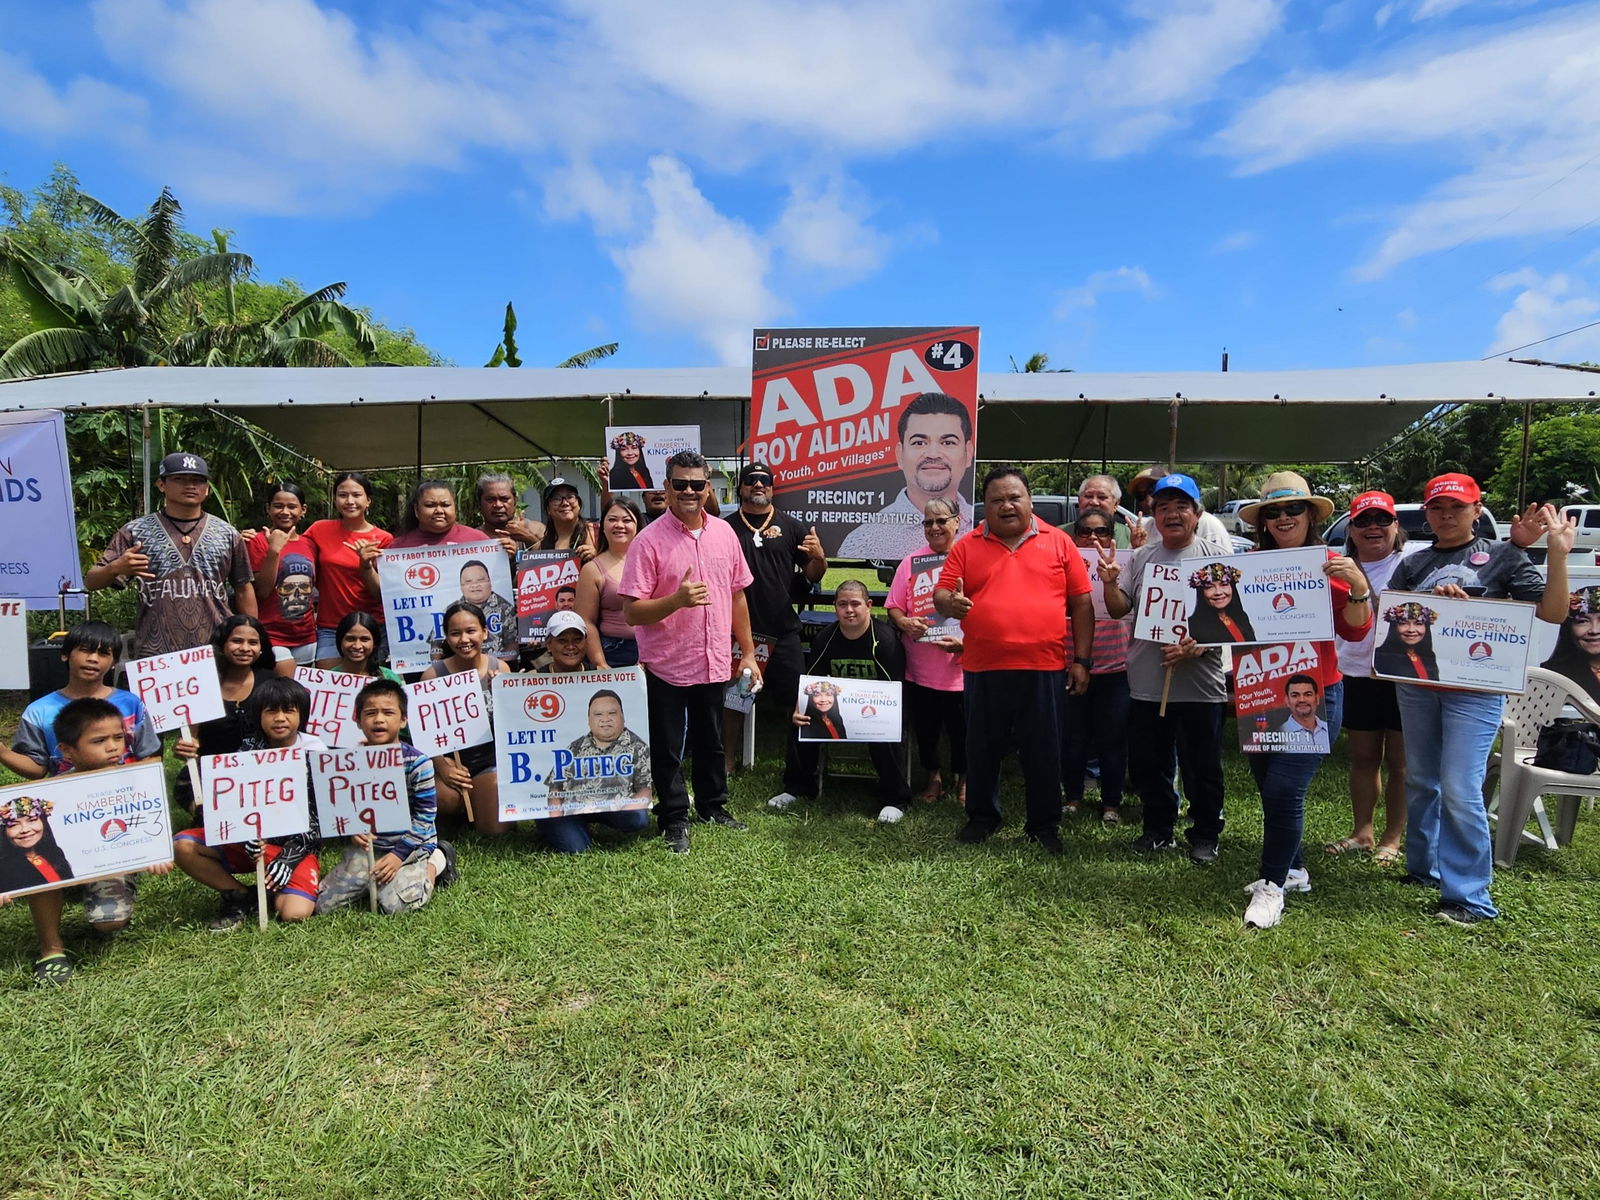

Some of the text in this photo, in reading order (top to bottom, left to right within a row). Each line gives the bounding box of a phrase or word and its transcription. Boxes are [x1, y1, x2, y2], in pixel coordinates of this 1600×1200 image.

[772, 336, 866, 349] PLEASE RE-ELECT
[931, 343, 963, 368] #4
[757, 348, 944, 436] ADA
[753, 412, 890, 467] ROY ALDAN
[780, 465, 814, 482] Youth,
[817, 460, 838, 473] Our
[807, 490, 885, 505] PRECINCT 1
[1372, 499, 1388, 507] ADA
[806, 511, 819, 522] OF
[822, 511, 920, 524] REPRESENTATIVES
[402, 552, 424, 560] FABOT
[452, 547, 478, 556] PLEASE
[289, 564, 308, 573] EDC
[408, 566, 436, 586] #9
[520, 560, 579, 589] ADA
[1153, 565, 1180, 582] PLS.
[1254, 571, 1312, 583] KIMBERLYN
[521, 574, 579, 595] ROY ALDAN
[914, 584, 934, 597] ROY
[1244, 579, 1324, 594] KING-HINDS
[393, 595, 433, 610] LET IT
[395, 615, 424, 642] B.
[1442, 627, 1526, 644] KING-HINDS
[1455, 620, 1516, 633] KIMBERLYN
[180, 649, 214, 664] VOTE
[1236, 641, 1318, 679] ADA
[443, 671, 474, 688] VOTE
[834, 664, 873, 677] YETI
[1238, 659, 1318, 688] ROY ALDAN
[503, 679, 519, 688] POT
[522, 677, 549, 686] FABOT
[552, 675, 574, 685] BOTA
[581, 674, 612, 683] PLEASE
[615, 673, 636, 682] VOTE
[138, 676, 199, 704] PITEG
[528, 694, 560, 718] #9
[842, 697, 898, 706] KING-HINDS
[418, 692, 479, 731] PITEG
[508, 729, 556, 745] LET IT
[1252, 732, 1310, 742] PRECINCT 1
[212, 748, 301, 769] PLS. VOTE
[366, 748, 402, 768] VOTE
[509, 752, 541, 784] B.
[77, 791, 147, 811] KIMBERLYN
[212, 777, 294, 810] PITEG
[328, 776, 399, 808] PITEG
[64, 798, 161, 825] KING-HINDS
